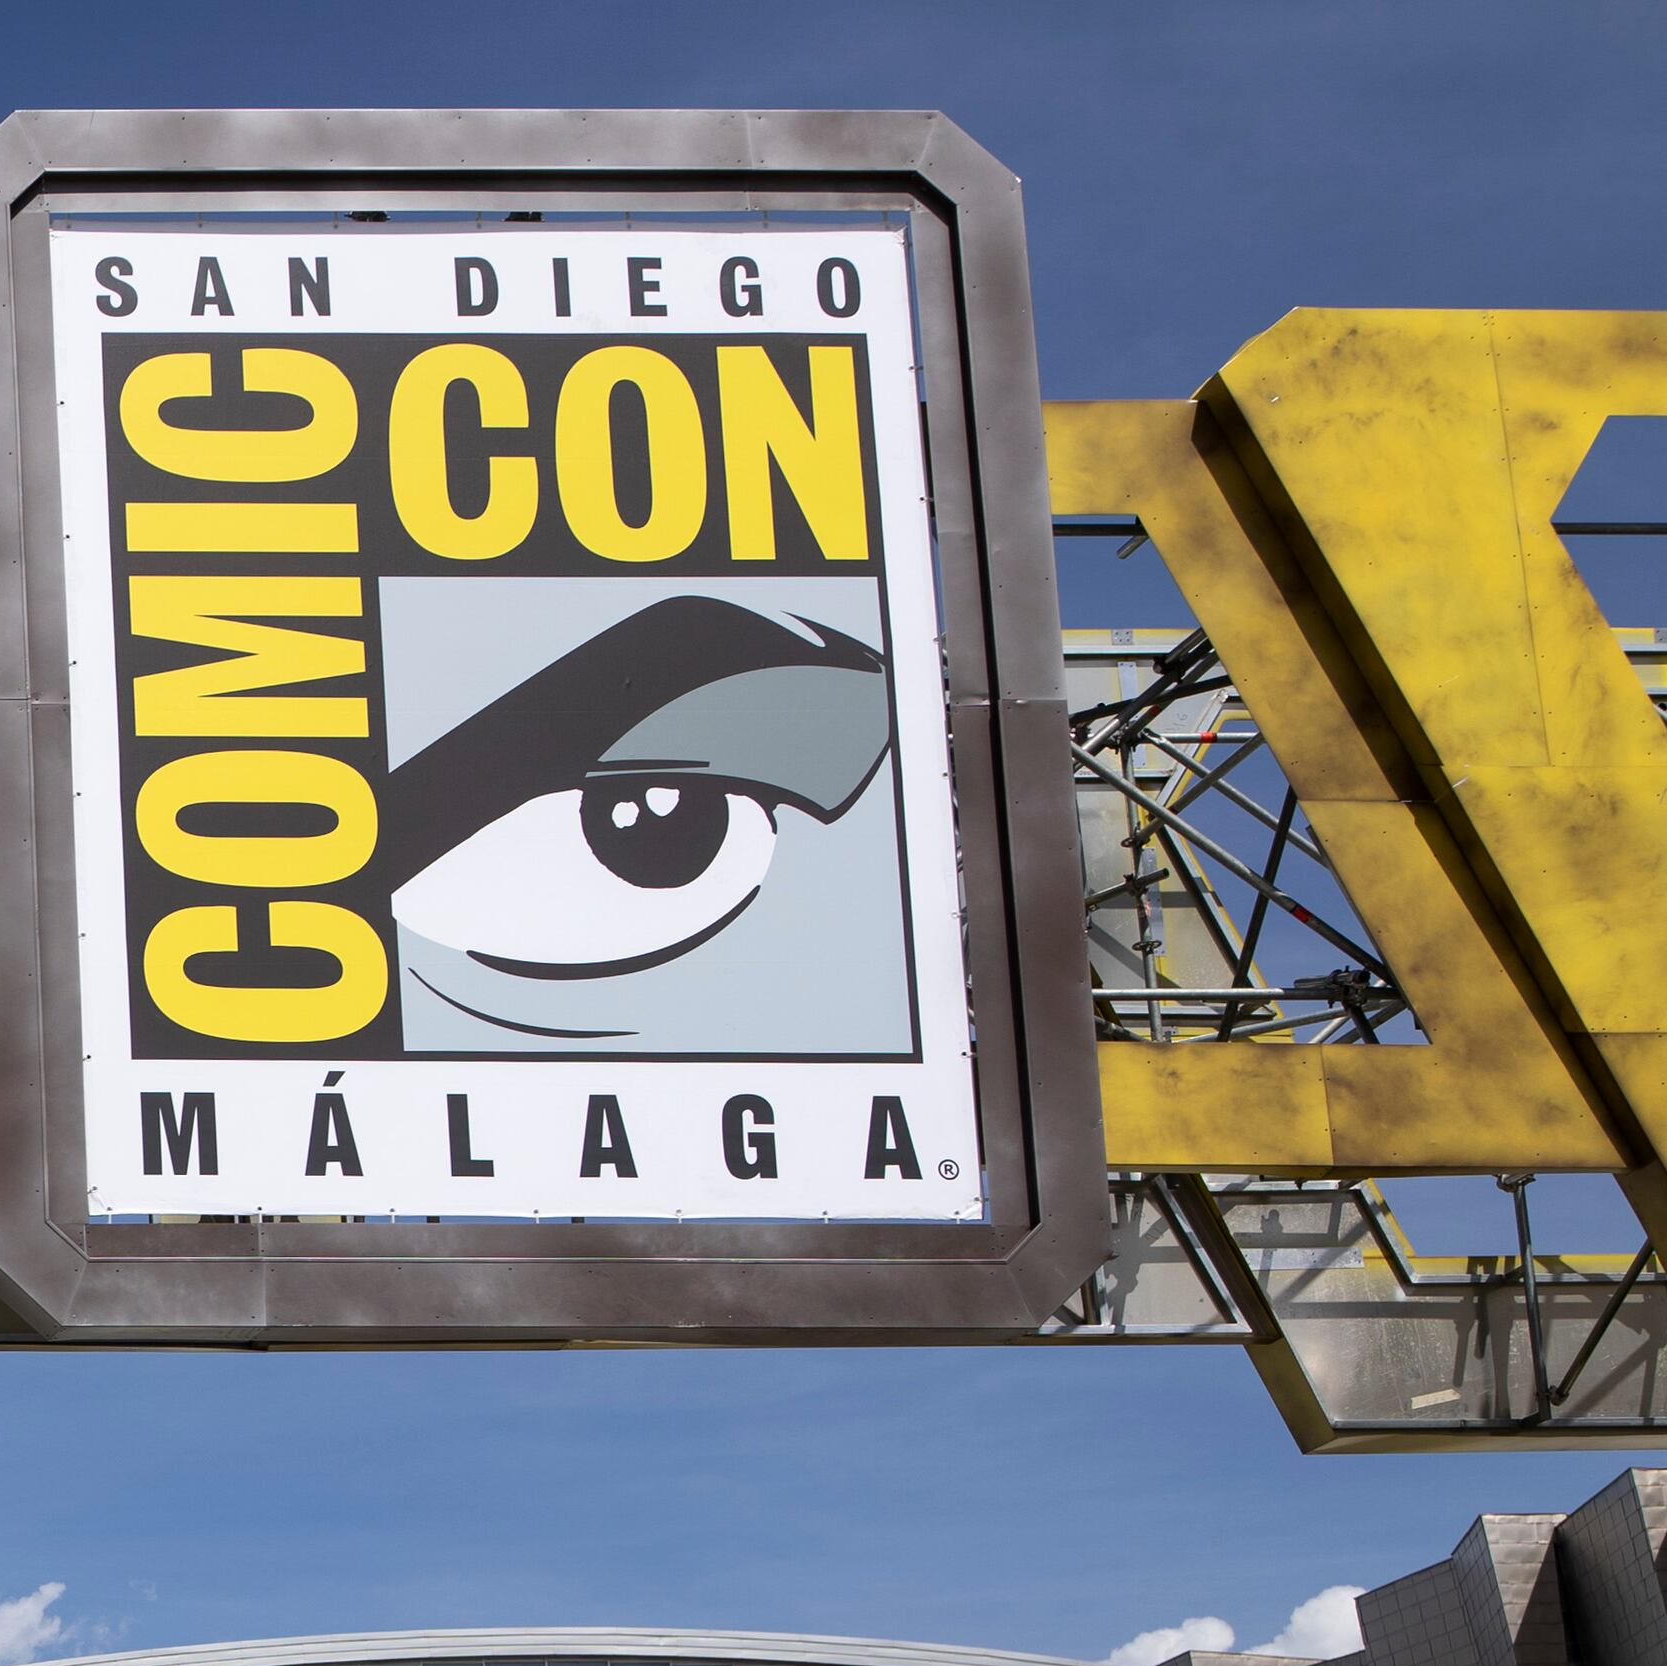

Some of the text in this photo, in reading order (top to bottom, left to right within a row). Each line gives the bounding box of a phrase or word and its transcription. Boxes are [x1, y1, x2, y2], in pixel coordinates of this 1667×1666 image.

[95, 256, 864, 318] SAN DIEGO
[389, 343, 871, 564] CON
[119, 346, 390, 1044] COMIC
